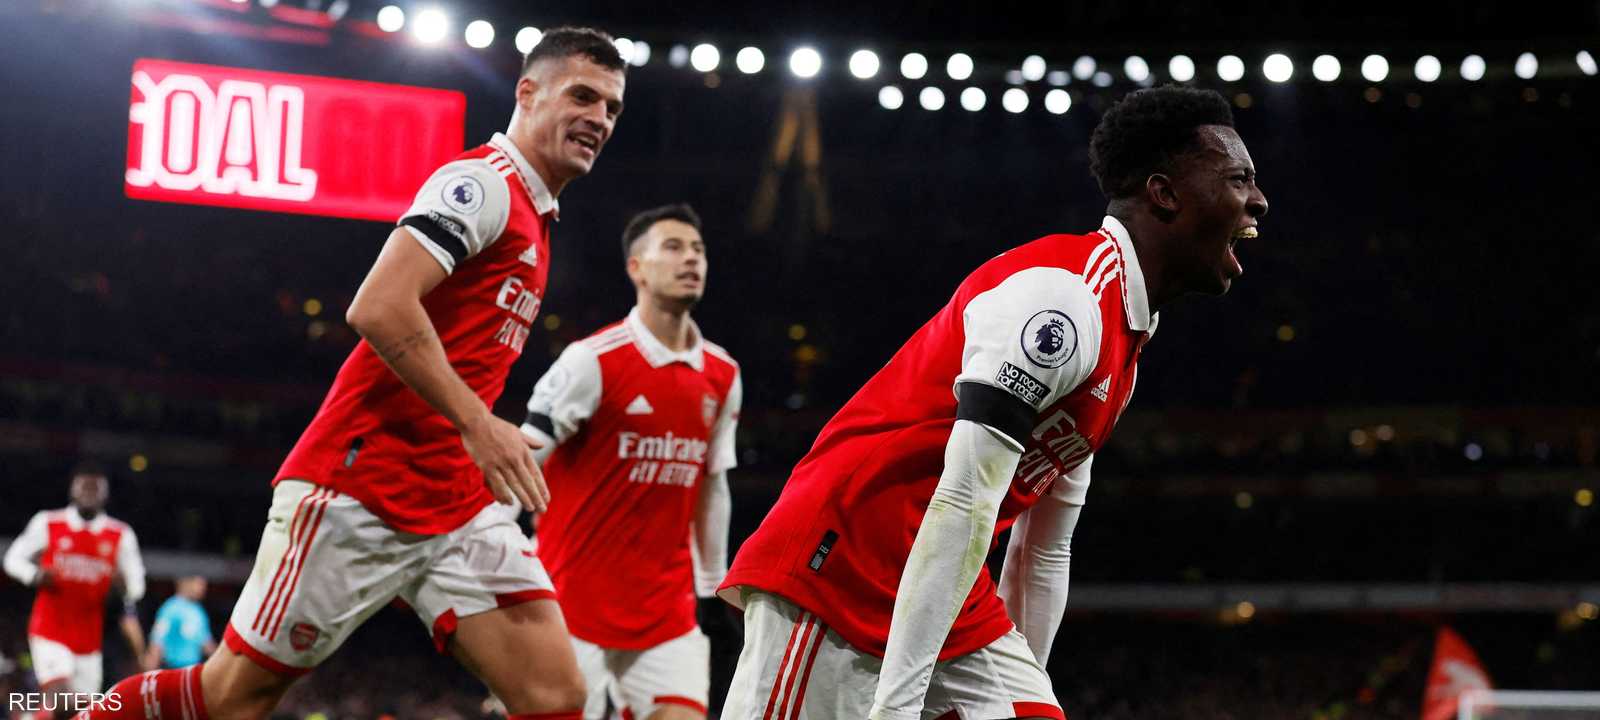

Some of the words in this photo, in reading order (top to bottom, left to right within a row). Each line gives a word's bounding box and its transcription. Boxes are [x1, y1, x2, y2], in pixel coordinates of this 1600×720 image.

[1000, 362, 1019, 378] No
[1019, 373, 1045, 396] room
[1013, 382, 1042, 405] racism
